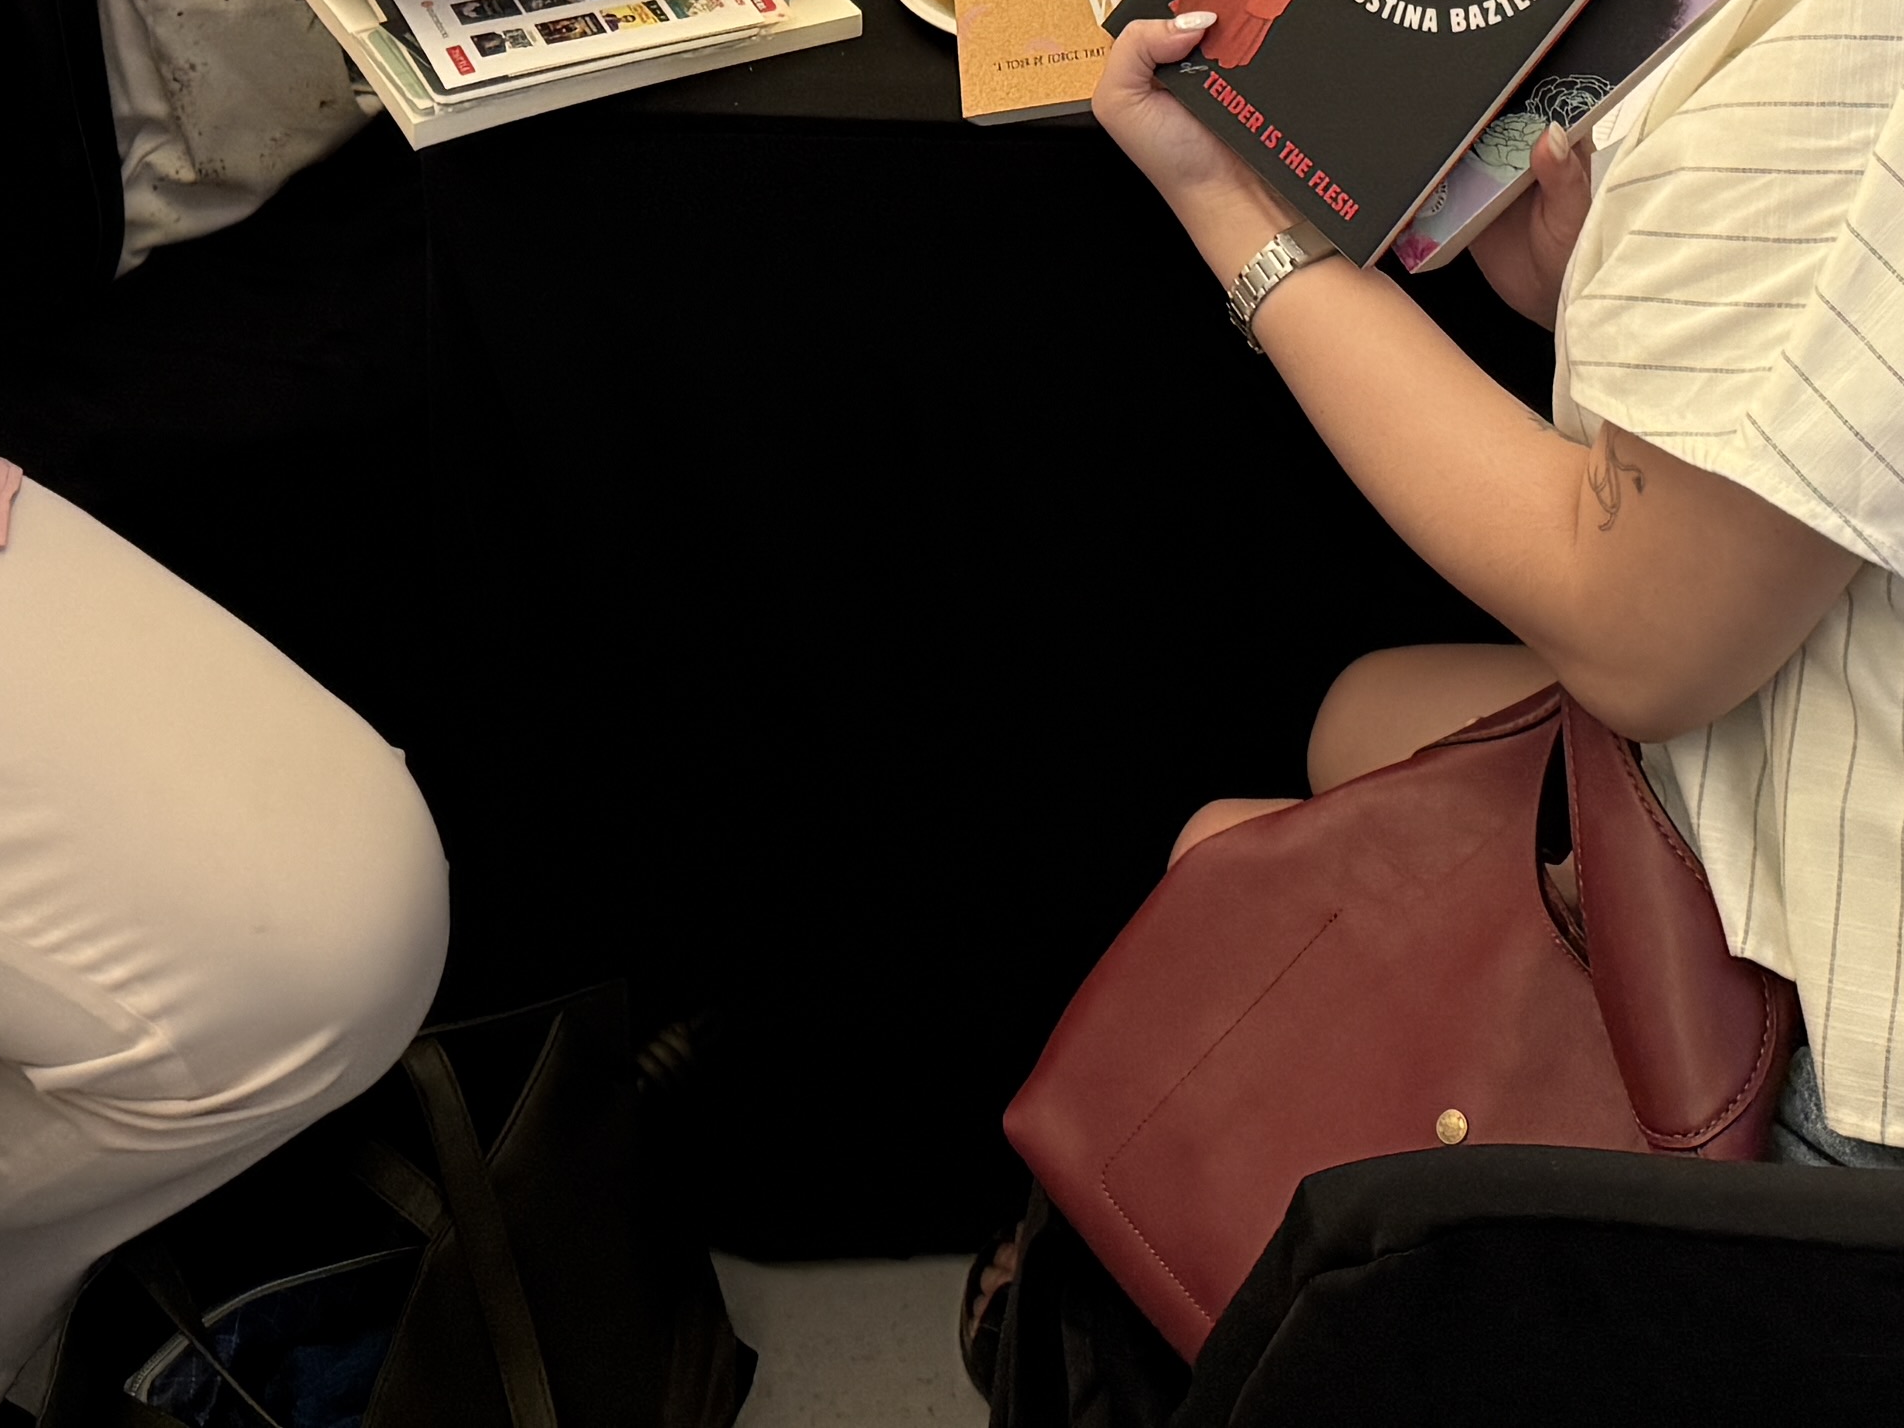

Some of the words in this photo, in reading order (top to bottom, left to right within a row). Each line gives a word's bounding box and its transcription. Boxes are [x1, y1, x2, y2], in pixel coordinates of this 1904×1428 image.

[1202, 70, 1265, 134] TENDER
[1259, 124, 1283, 150] IS
[1278, 140, 1314, 179] THE
[1307, 169, 1361, 222] FLESH
